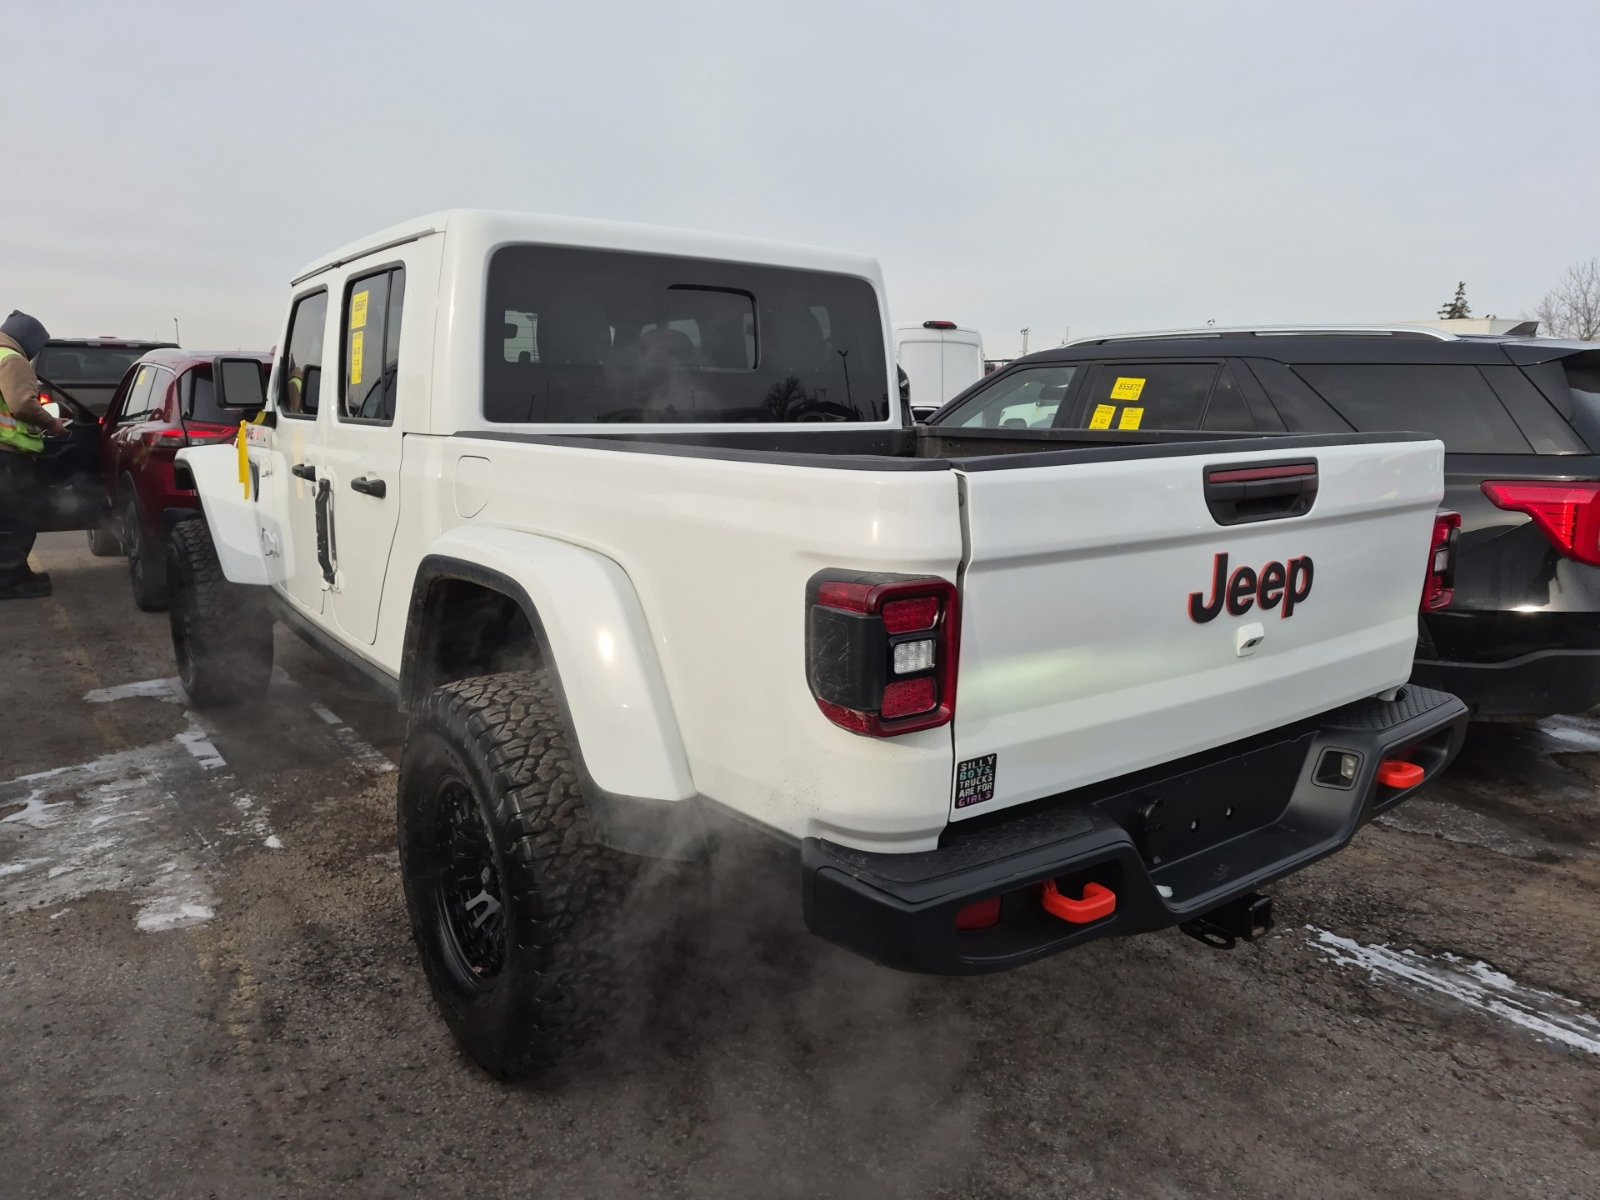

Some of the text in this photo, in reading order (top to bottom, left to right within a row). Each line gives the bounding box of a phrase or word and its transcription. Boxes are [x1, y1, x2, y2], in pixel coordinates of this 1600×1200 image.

[1187, 552, 1314, 624] Jeep
[960, 756, 994, 771] SILLY
[960, 774, 993, 789] TRUCKS
[959, 782, 993, 798] ARE FOR
[959, 791, 992, 806] GIRLS
